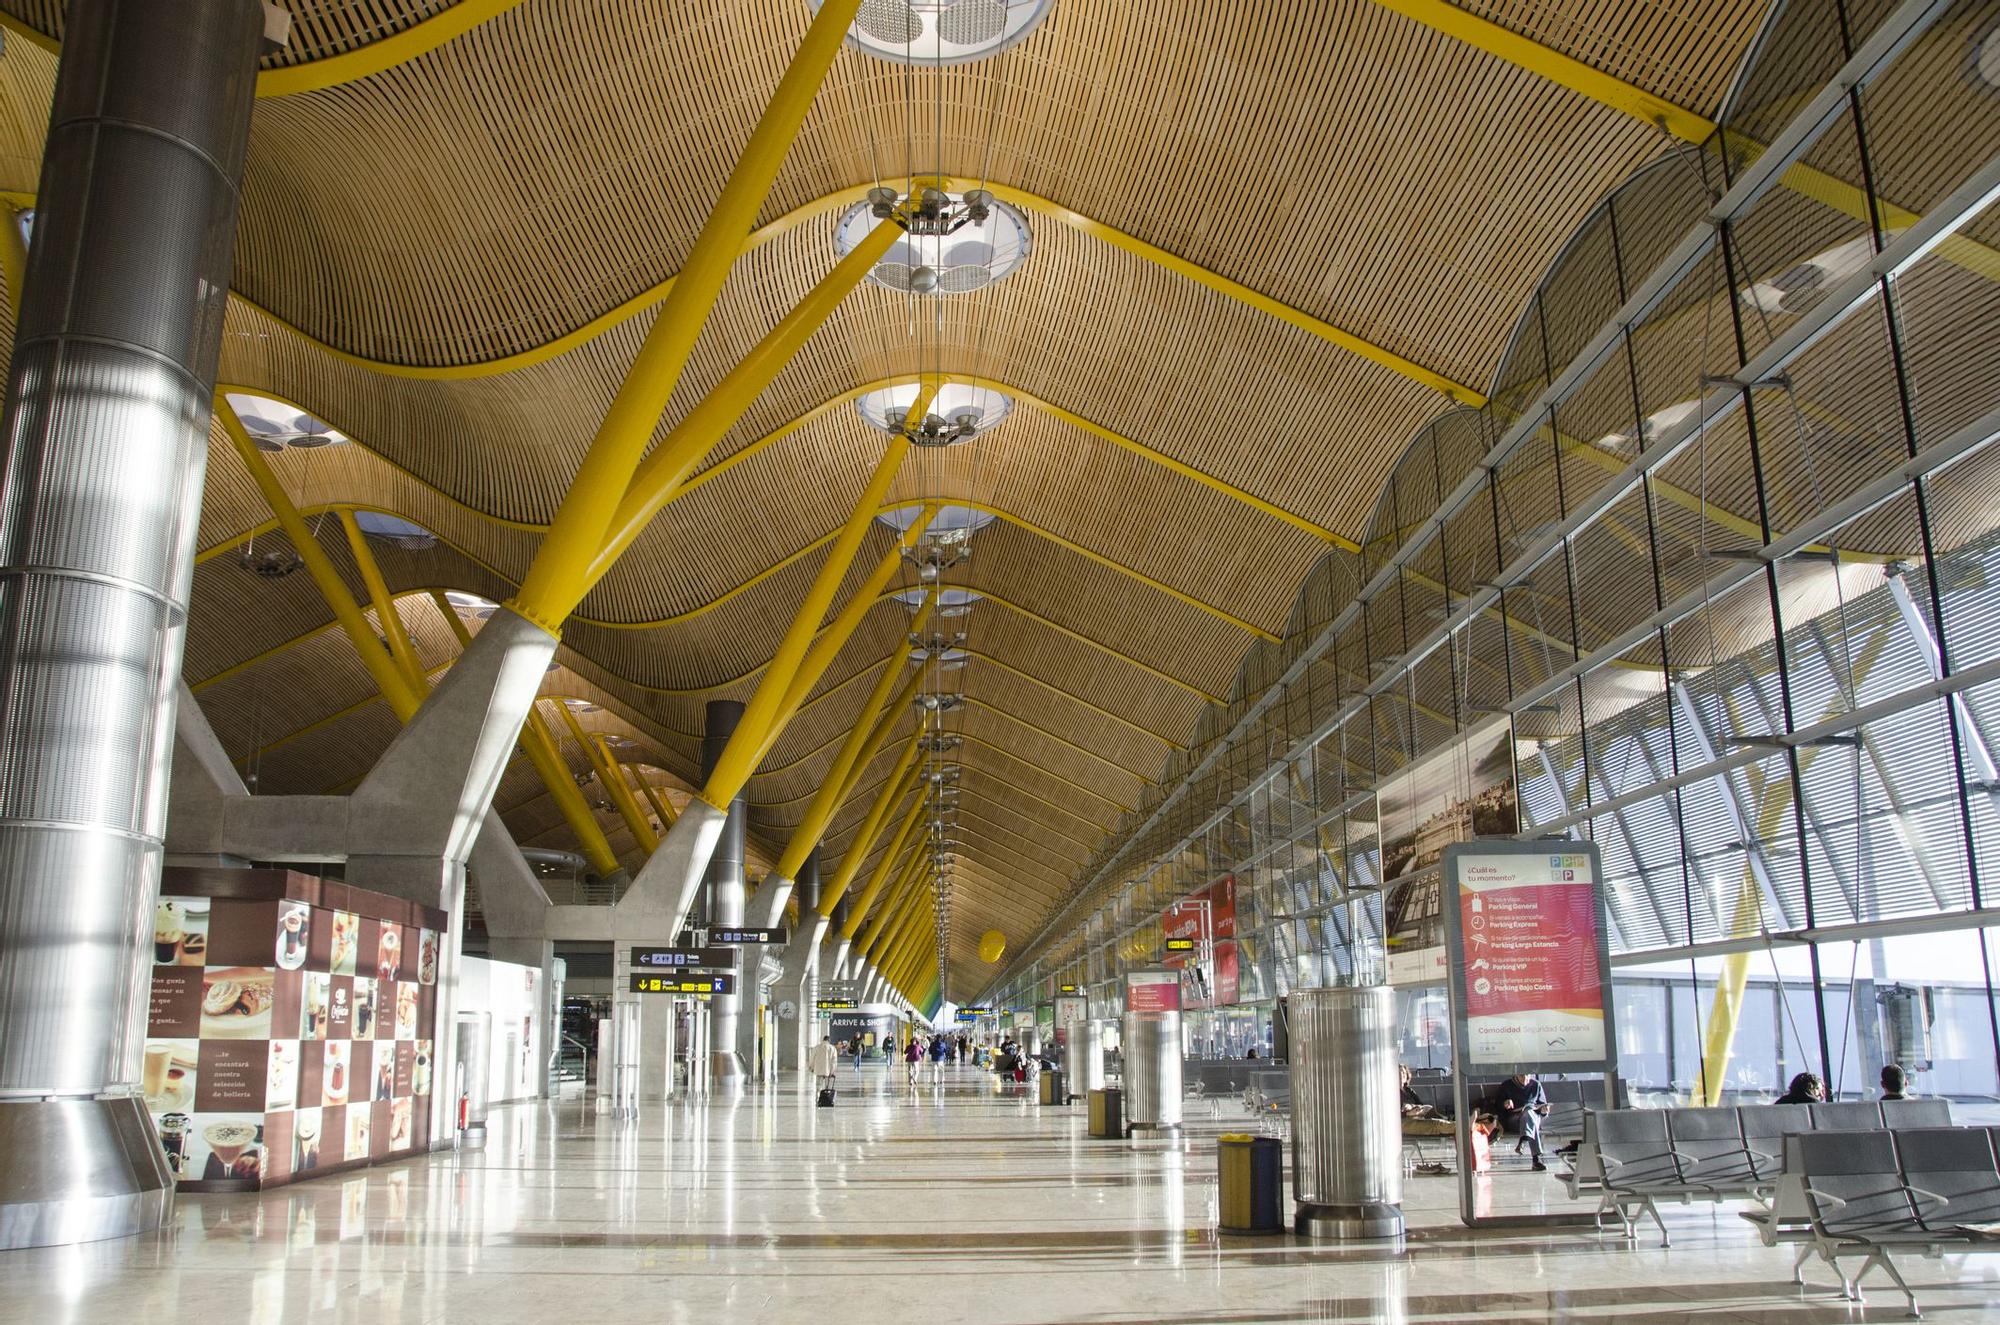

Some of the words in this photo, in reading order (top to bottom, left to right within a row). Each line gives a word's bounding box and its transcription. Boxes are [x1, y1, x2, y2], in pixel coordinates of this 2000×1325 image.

[1467, 865, 1487, 874] ¿Cuál
[1476, 874, 1516, 882] momento?
[1488, 903, 1513, 911] Parking
[1490, 921, 1513, 929] Parking
[1515, 942, 1532, 950] Larga
[1533, 940, 1559, 948] Estancia
[715, 982, 722, 990] K
[1495, 984, 1518, 992] Parking
[832, 1018, 858, 1026] ARRIVE
[859, 1018, 866, 1026] &
[1478, 1025, 1521, 1034] Comodidad
[1523, 1024, 1557, 1034] Seguridad
[1559, 1024, 1590, 1032] Cercanía
